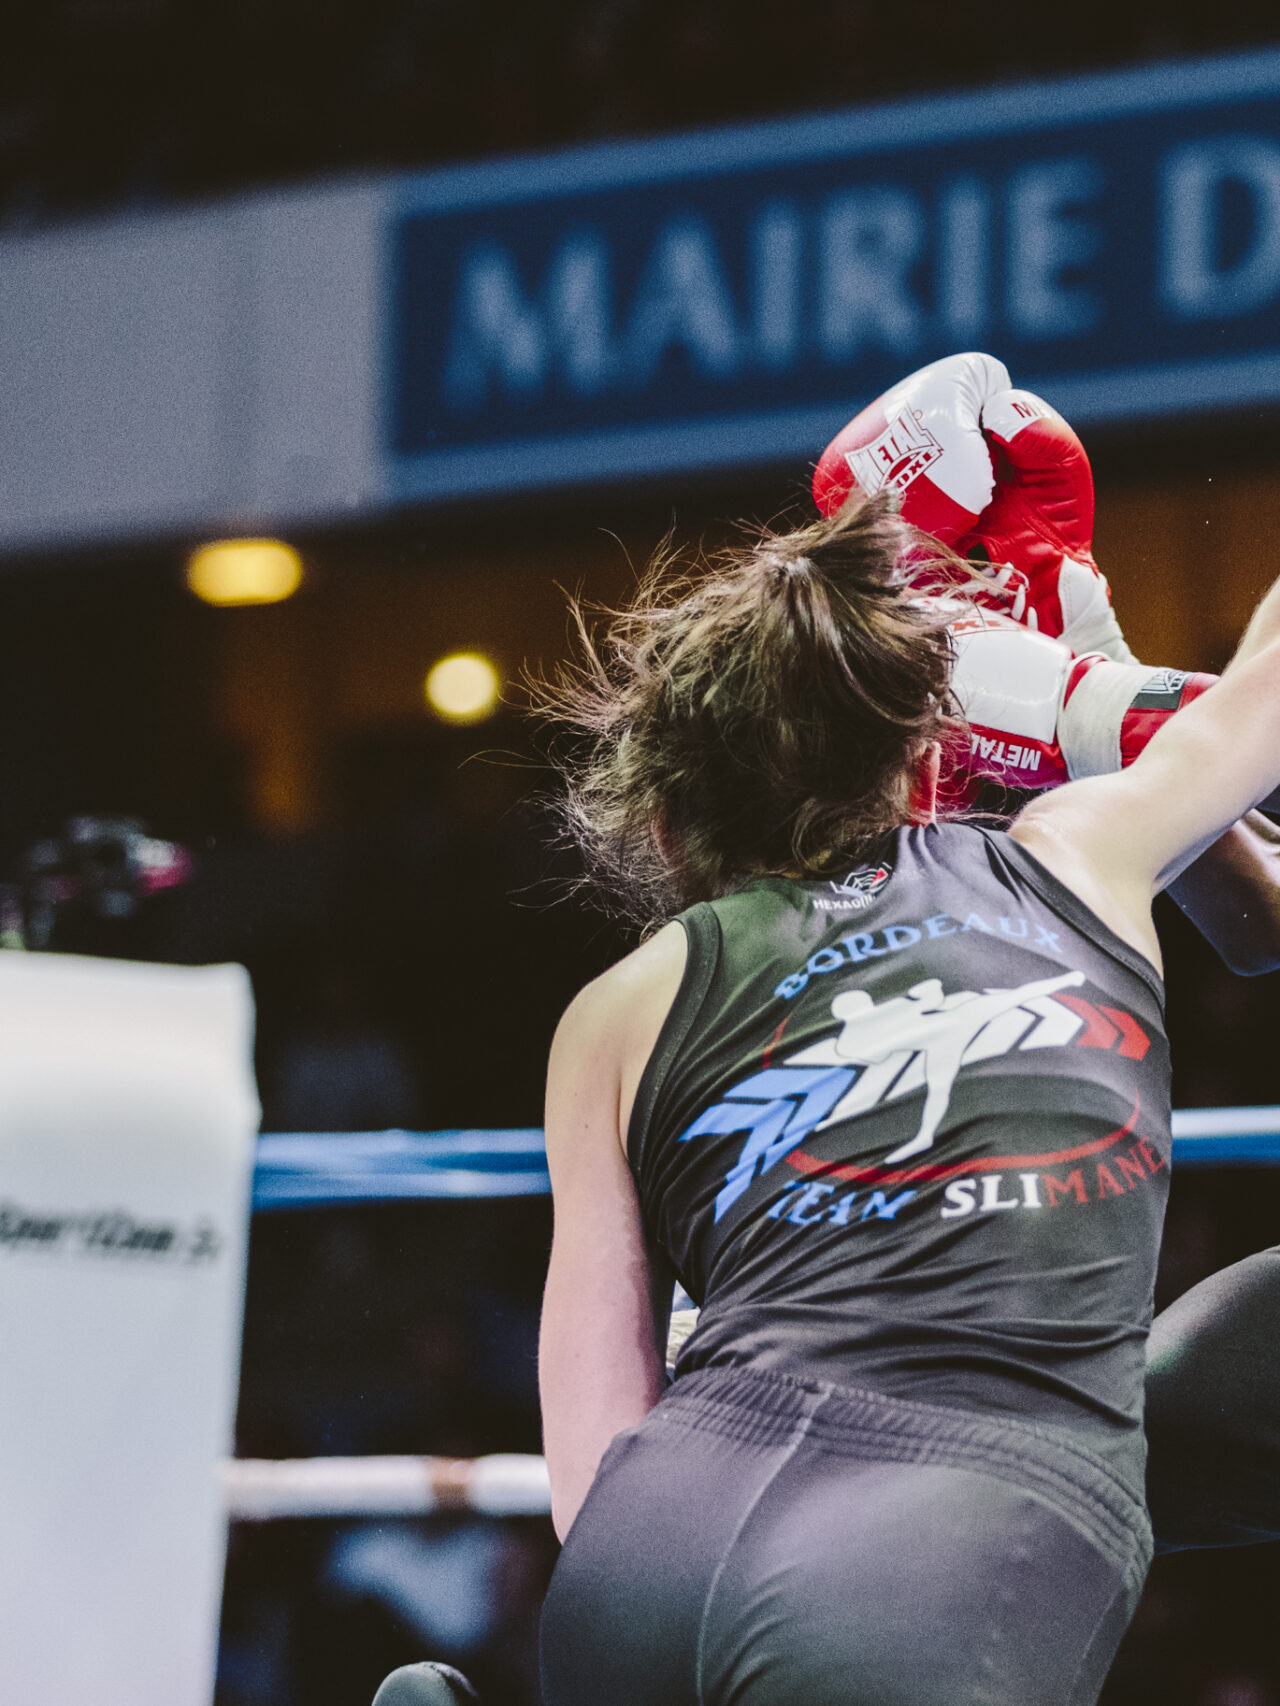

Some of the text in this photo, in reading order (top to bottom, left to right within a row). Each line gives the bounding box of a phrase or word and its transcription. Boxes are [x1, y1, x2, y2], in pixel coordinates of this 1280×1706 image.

[441, 155, 1104, 410] MAIRIE
[773, 911, 1063, 1000] BORDEAUX
[766, 1136, 1166, 1226] TEAM SLIMANE
